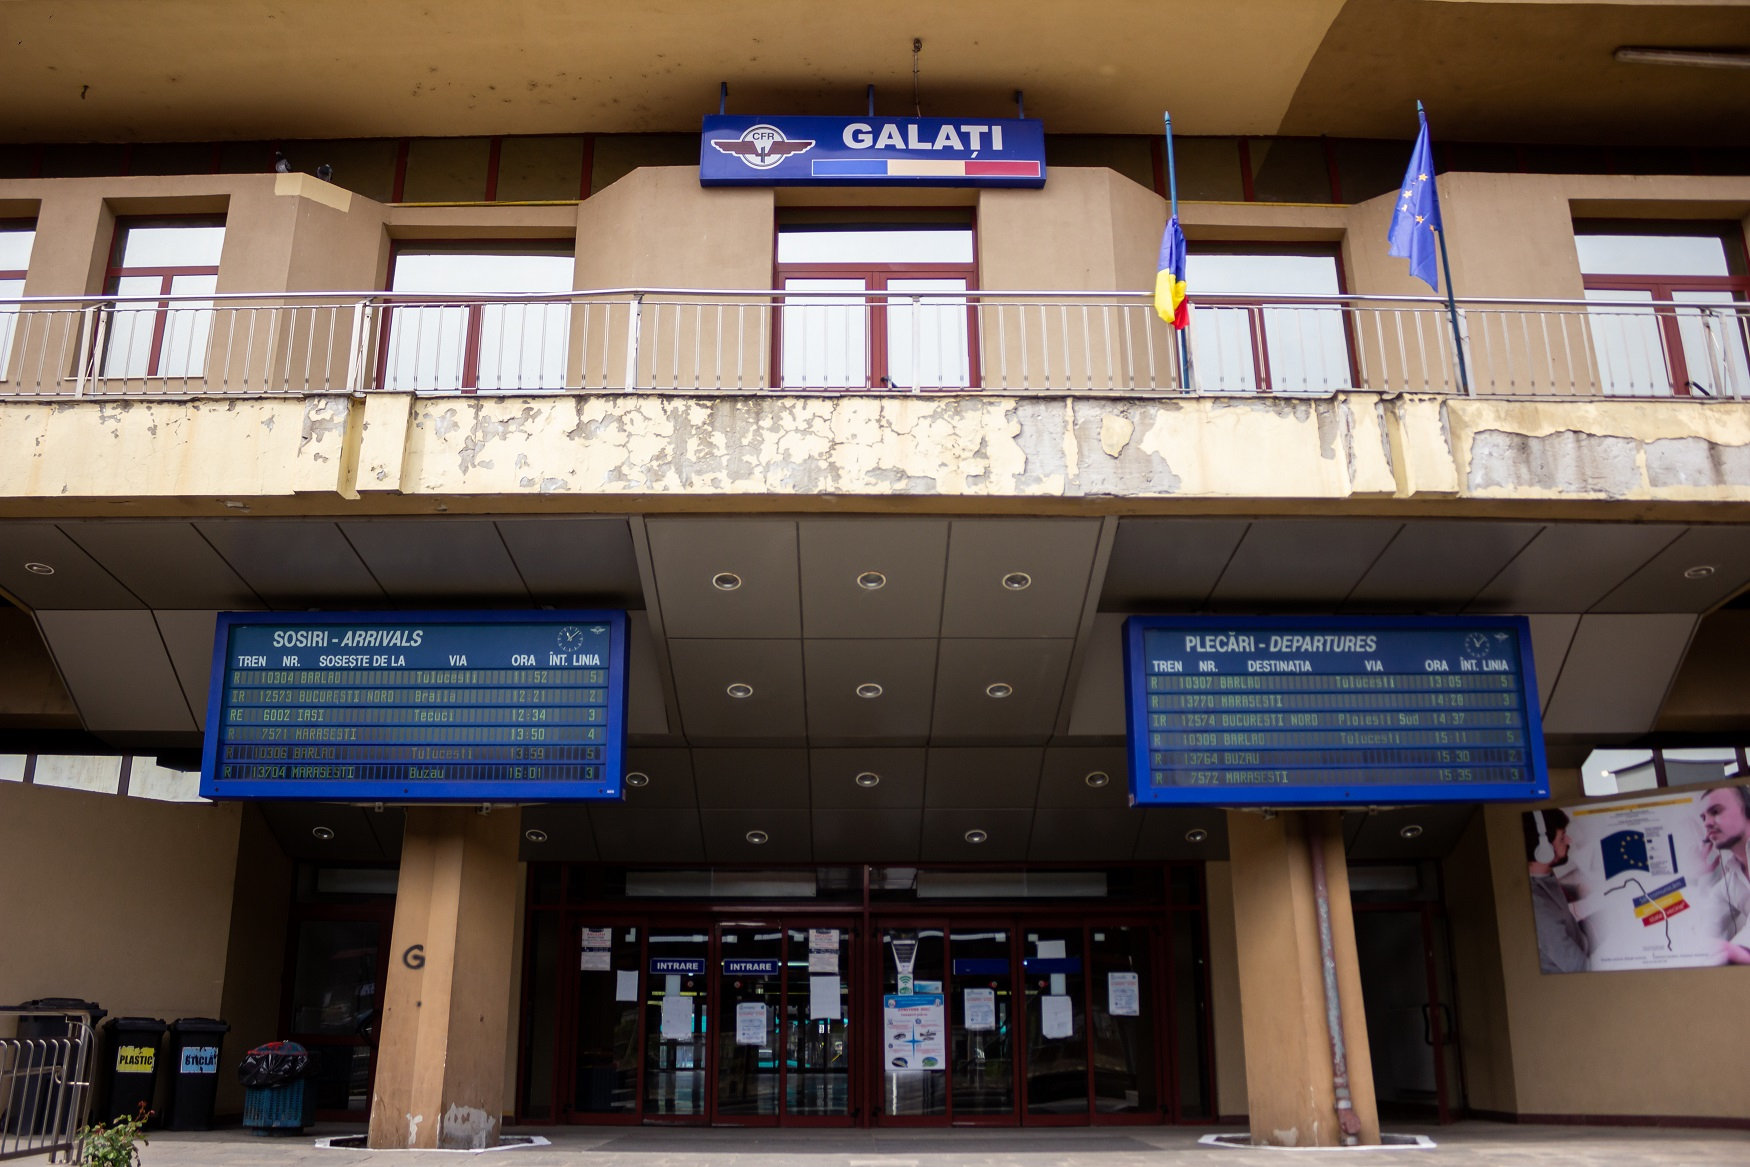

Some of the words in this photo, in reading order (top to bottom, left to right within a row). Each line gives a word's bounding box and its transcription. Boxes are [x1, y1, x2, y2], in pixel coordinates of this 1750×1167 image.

[752, 132, 775, 141] CFR
[842, 123, 1003, 158] GALAȚI
[273, 631, 328, 648] SOSIRI
[340, 630, 424, 646] ARRIVALS
[1186, 632, 1254, 652] PLECĂRI
[1270, 635, 1377, 652] DEPARTURES
[238, 656, 266, 667] TREN
[282, 656, 300, 667] NR.
[373, 656, 388, 666] DE
[391, 656, 406, 666] LA
[449, 654, 468, 666] VIA
[512, 654, 536, 666] ORA
[549, 652, 568, 666] ÎNT.
[572, 654, 600, 666] LINIA
[1152, 660, 1182, 672] TREN
[1199, 660, 1218, 672] NR.
[1364, 660, 1384, 672] VIA
[1425, 660, 1449, 672] ORA
[1460, 656, 1479, 672] ÎNT.
[1482, 660, 1509, 672] LINIA
[234, 671, 240, 684] R
[261, 671, 294, 684] 10304
[513, 671, 548, 683] 11:52
[590, 671, 597, 683] 5
[1151, 676, 1158, 689] R
[1179, 676, 1213, 689] 10307
[1429, 676, 1462, 688] 13:05
[1500, 676, 1508, 688] 5
[232, 690, 245, 702] IR
[259, 690, 292, 702] 12573
[414, 690, 456, 702] Braila
[512, 690, 546, 702] 12:21
[589, 690, 596, 702] 2
[1152, 696, 1159, 708] R
[1221, 696, 1284, 708] MARASESTI
[1503, 694, 1510, 706] 3
[230, 709, 244, 721] RE
[263, 709, 290, 721] 6002
[297, 709, 324, 721] IASI
[414, 708, 454, 721] Tecuci
[511, 708, 546, 721] 12:34
[588, 708, 596, 720] 3
[1152, 714, 1166, 726] IR
[1182, 714, 1216, 726] 12574
[1222, 714, 1284, 726] BUCURESTI
[1399, 714, 1420, 725] Sud
[1433, 713, 1465, 725] 14:37
[1504, 713, 1512, 724] 2
[228, 728, 235, 740] R
[261, 728, 288, 740] 7571
[511, 728, 545, 740] 13:50
[587, 728, 595, 740] 4
[1154, 734, 1161, 746] R
[1183, 734, 1217, 746] 10309
[1435, 732, 1467, 744] 15:11
[1506, 732, 1514, 743] 5
[226, 747, 232, 760] R
[510, 747, 545, 760] 13:59
[586, 747, 594, 760] 5
[1154, 752, 1162, 764] R
[1224, 752, 1260, 764] BUZAU
[1437, 750, 1470, 762] 15:30
[224, 766, 231, 779] R
[251, 766, 286, 779] 13704
[292, 766, 354, 779] MARASESTI
[409, 766, 444, 779] Buzau
[508, 766, 542, 779] 16:01
[586, 766, 594, 779] 3
[1156, 772, 1163, 784] R
[1191, 772, 1219, 784] 7572
[1226, 772, 1288, 784] MARASESTI
[1439, 770, 1472, 781] 15:35
[1512, 770, 1519, 780] 3
[402, 944, 426, 970] G
[656, 962, 699, 970] INTRARE
[730, 962, 772, 971] INTRARE
[119, 1055, 153, 1066] PLASTIC
